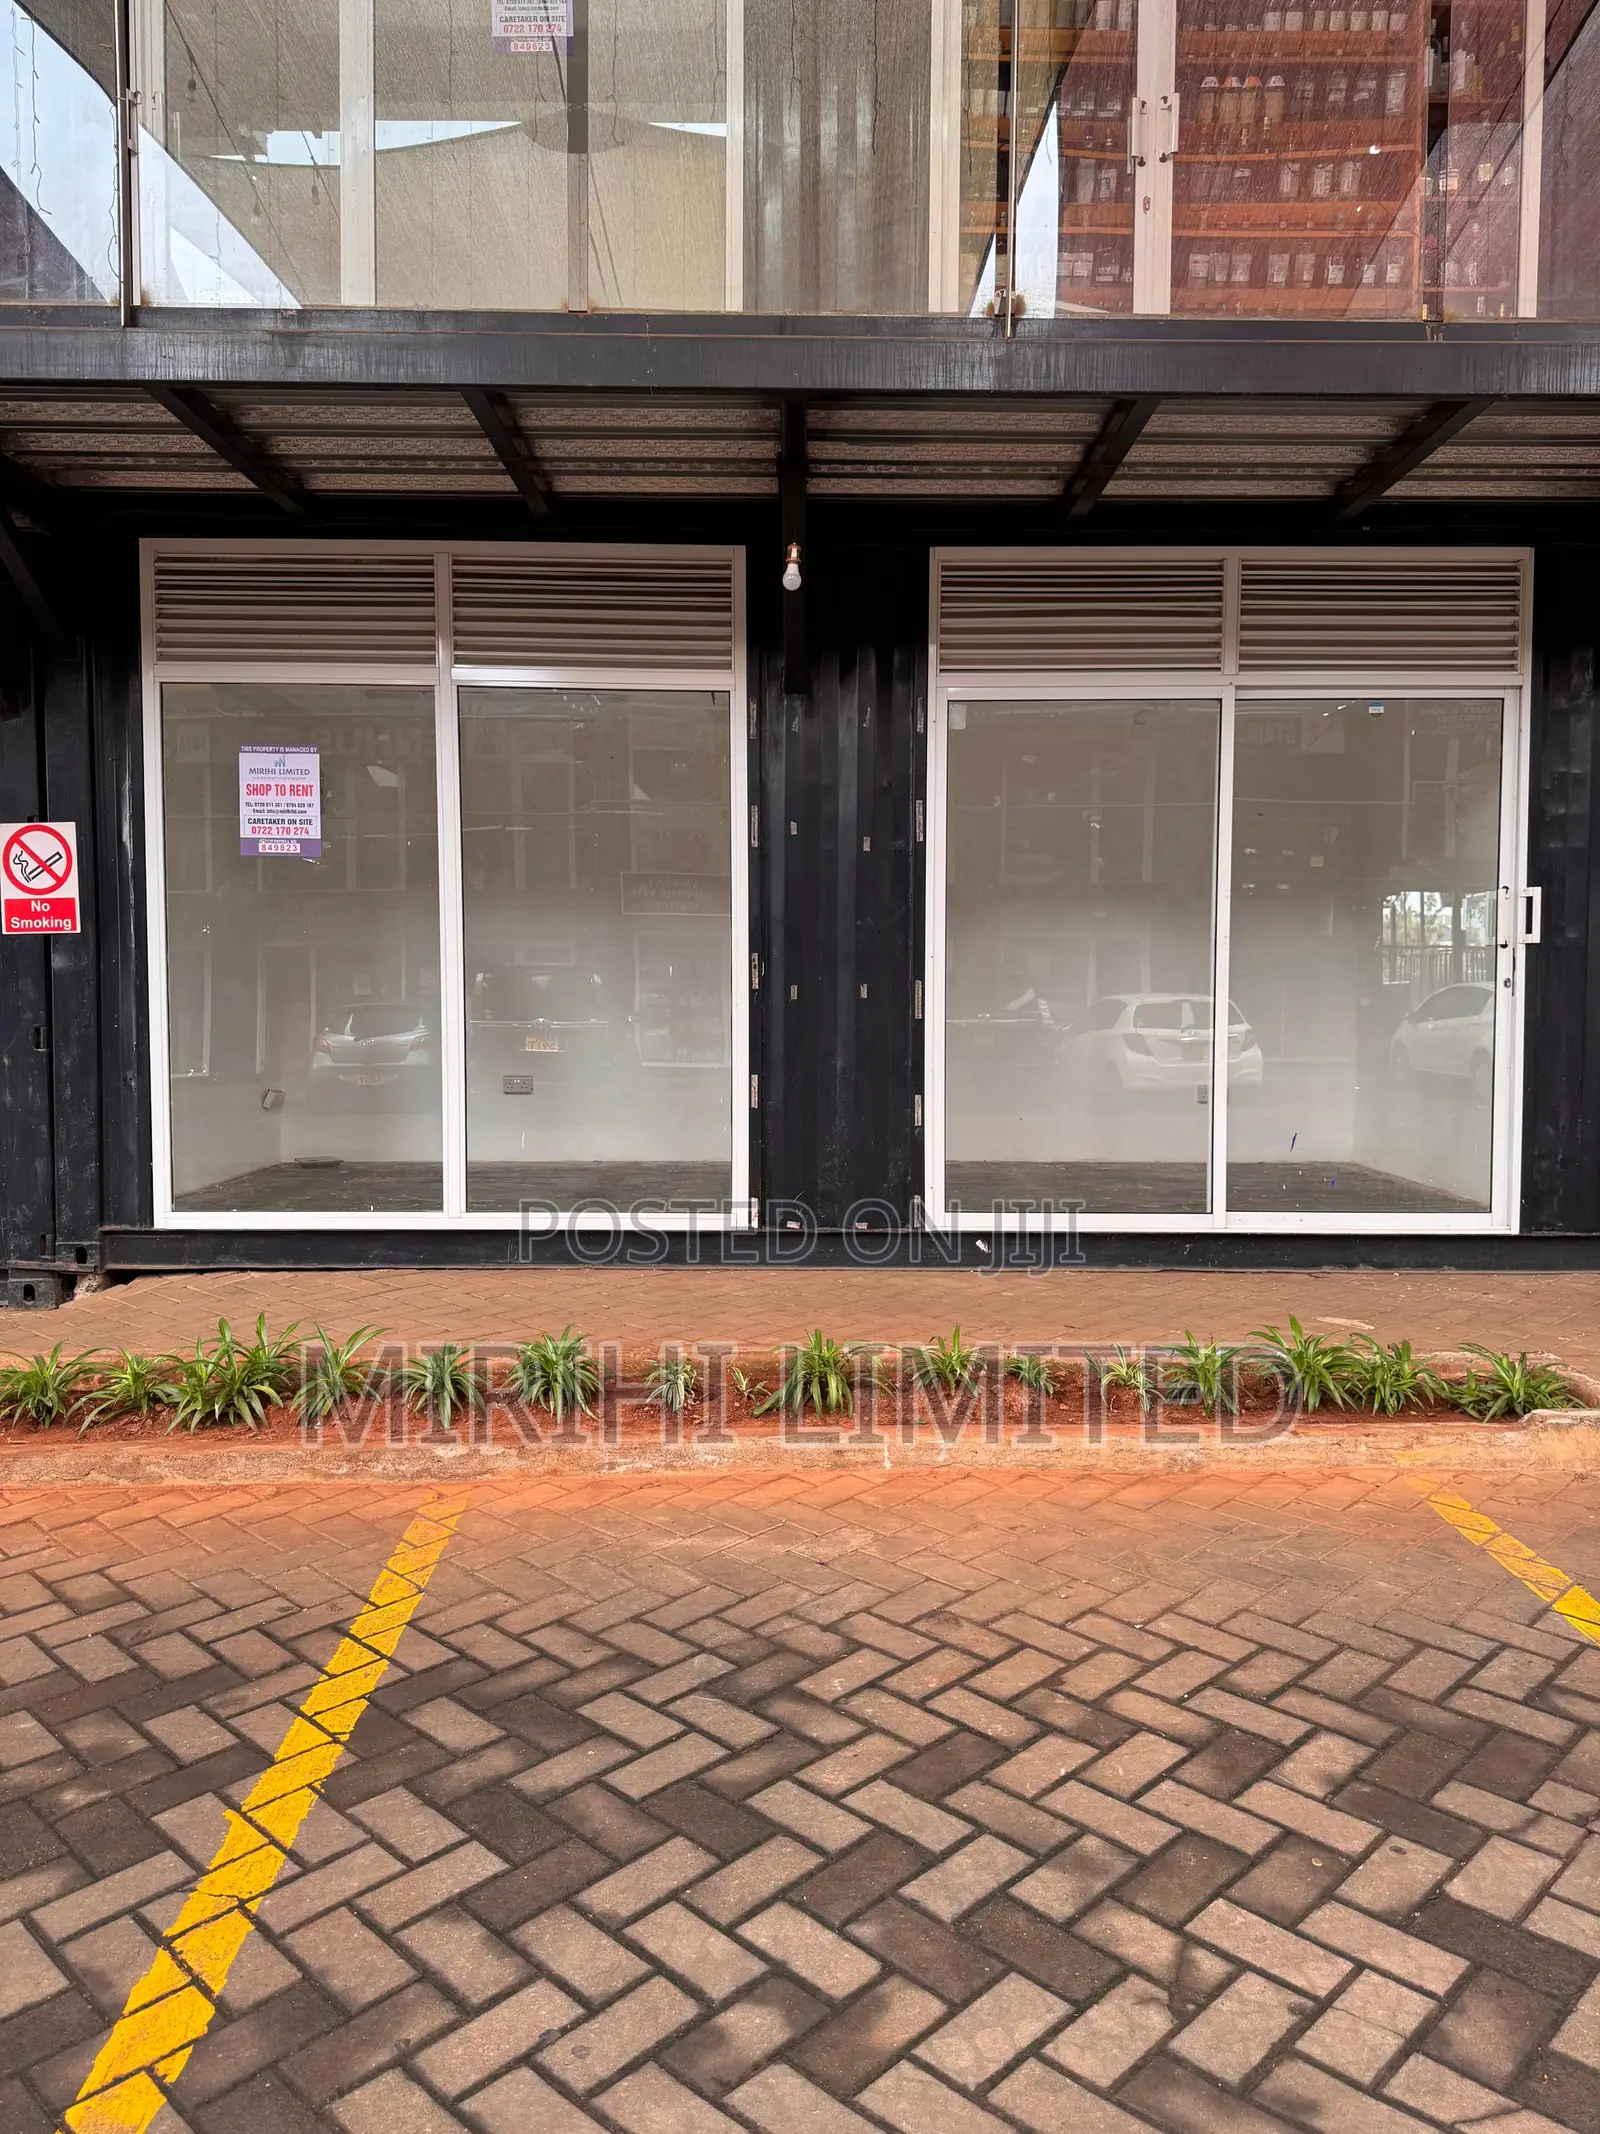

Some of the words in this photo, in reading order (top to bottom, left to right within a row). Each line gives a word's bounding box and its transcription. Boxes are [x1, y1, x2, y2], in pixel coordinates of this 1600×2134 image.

[503, 24, 524, 33] 0722
[528, 24, 543, 33] 170
[546, 24, 562, 33] 274
[513, 42, 550, 50] 849823
[279, 768, 310, 776] LIMITED
[246, 784, 271, 797] SHOP
[274, 784, 286, 797] TO
[289, 784, 314, 797] RENT
[251, 826, 272, 835] 0722
[276, 826, 291, 835] 170
[293, 827, 309, 835] 274
[261, 844, 298, 852] 849823
[31, 900, 50, 912] No
[11, 917, 72, 930] Smoking
